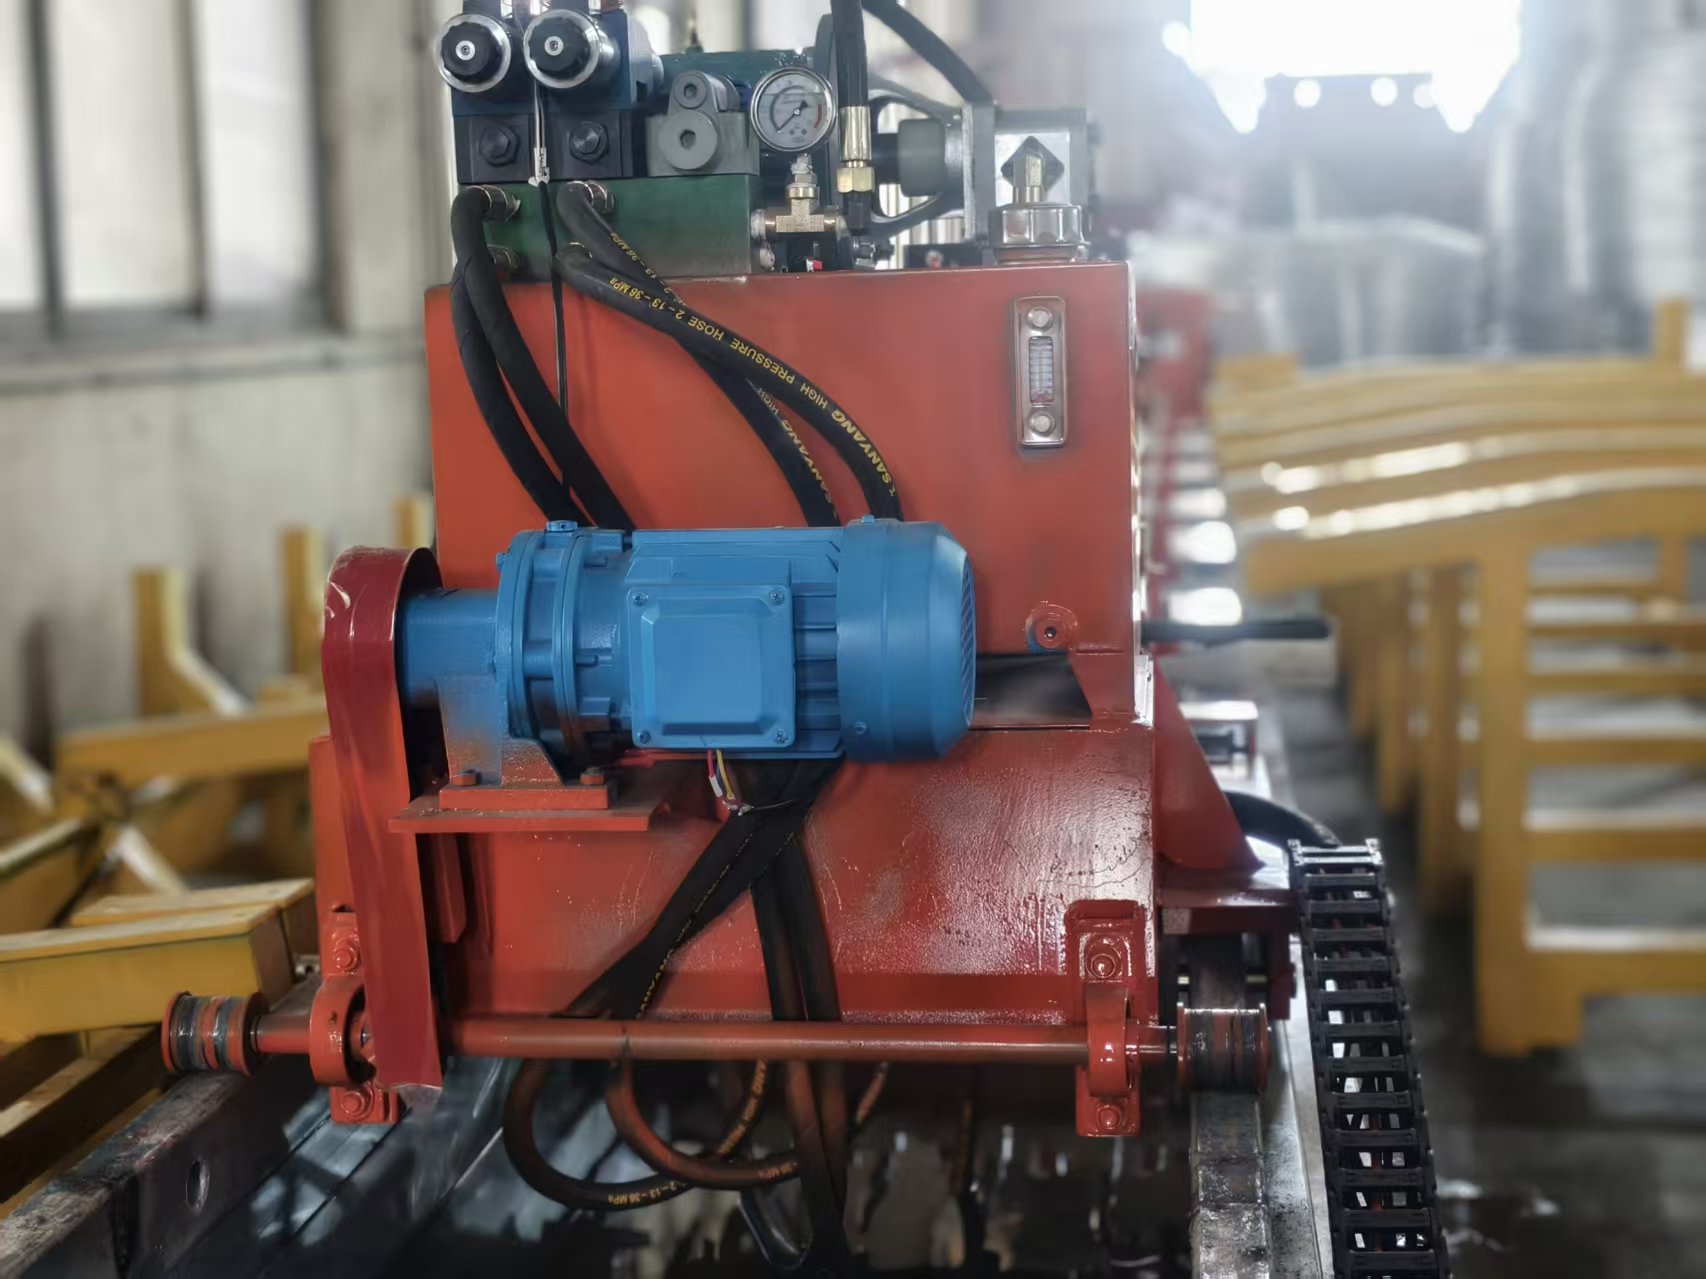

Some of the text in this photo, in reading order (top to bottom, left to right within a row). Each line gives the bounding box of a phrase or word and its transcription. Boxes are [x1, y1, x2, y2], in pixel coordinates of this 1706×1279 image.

[687, 315, 725, 341] HOSE
[730, 338, 796, 384] PRESSURE
[800, 383, 828, 409] HIGH
[831, 409, 892, 484] SANYANG
